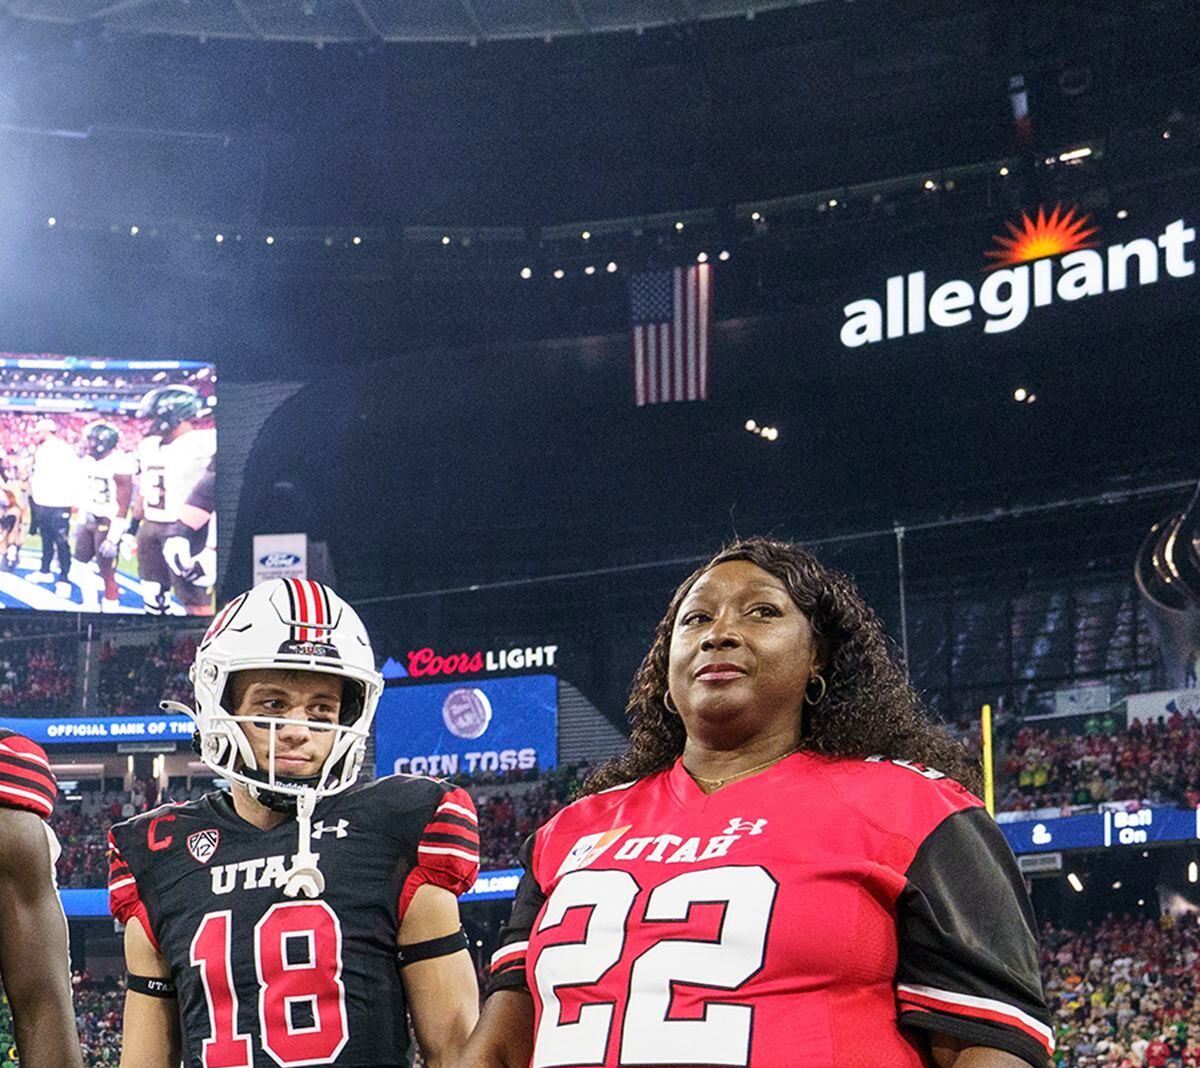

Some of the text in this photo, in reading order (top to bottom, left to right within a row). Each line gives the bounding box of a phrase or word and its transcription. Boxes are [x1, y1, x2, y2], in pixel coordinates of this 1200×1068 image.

[840, 219, 1196, 348] allegiant
[407, 645, 558, 677] Coors LIGHT
[47, 723, 107, 737] OFFICIAL
[110, 723, 145, 736] BANK
[147, 721, 167, 735] OF
[394, 748, 536, 777] COIN TOSS
[147, 815, 177, 851] C
[1119, 828, 1147, 844] On
[196, 844, 212, 858] 12
[614, 834, 741, 864] UTAH
